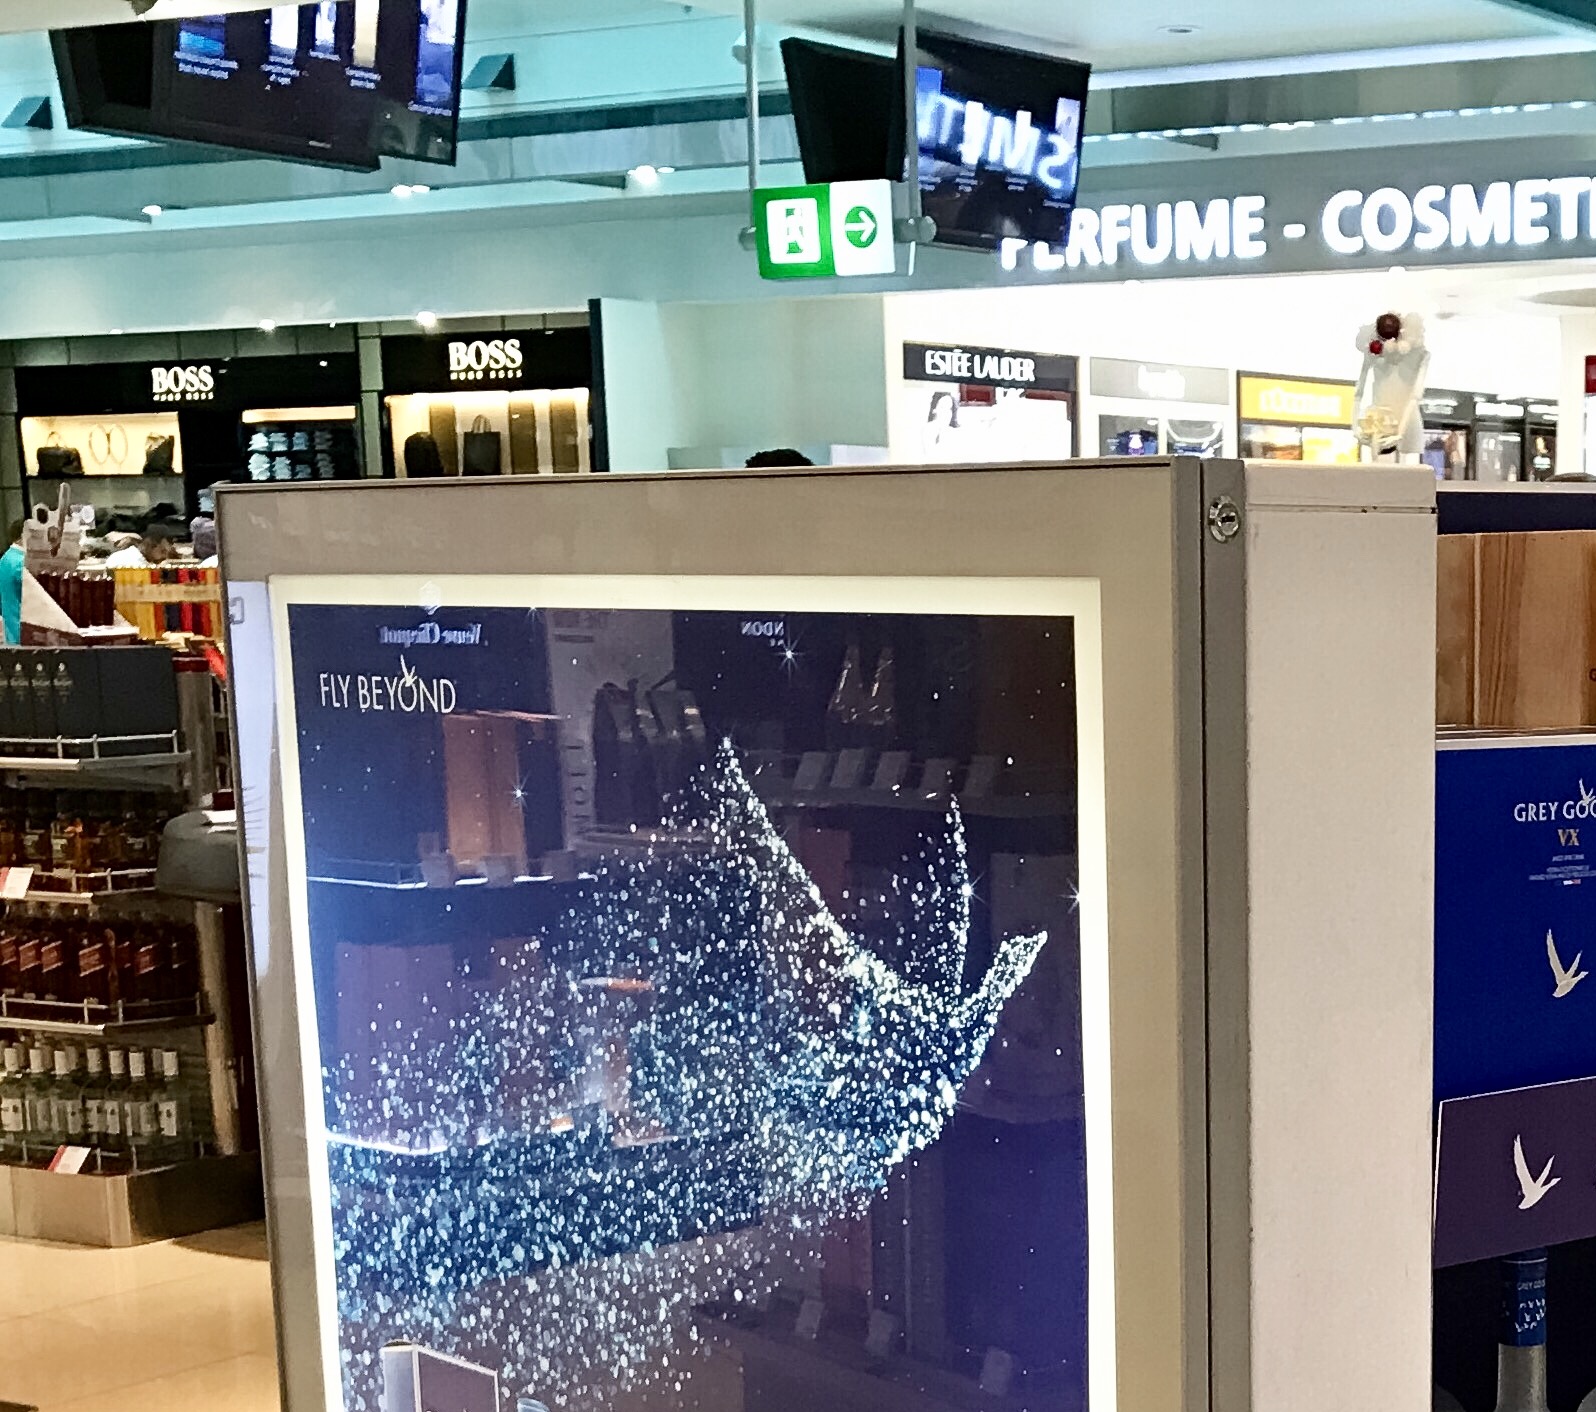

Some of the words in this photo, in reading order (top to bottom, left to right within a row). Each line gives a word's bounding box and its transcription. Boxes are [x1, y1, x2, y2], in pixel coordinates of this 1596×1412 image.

[448, 339, 523, 371] BOSS
[974, 355, 1036, 382] LAUDER
[152, 366, 214, 393] BOSS
[320, 673, 351, 709] FLY
[358, 675, 457, 714] BEYOND
[1513, 801, 1559, 822] GREY
[1557, 828, 1580, 847] VX
